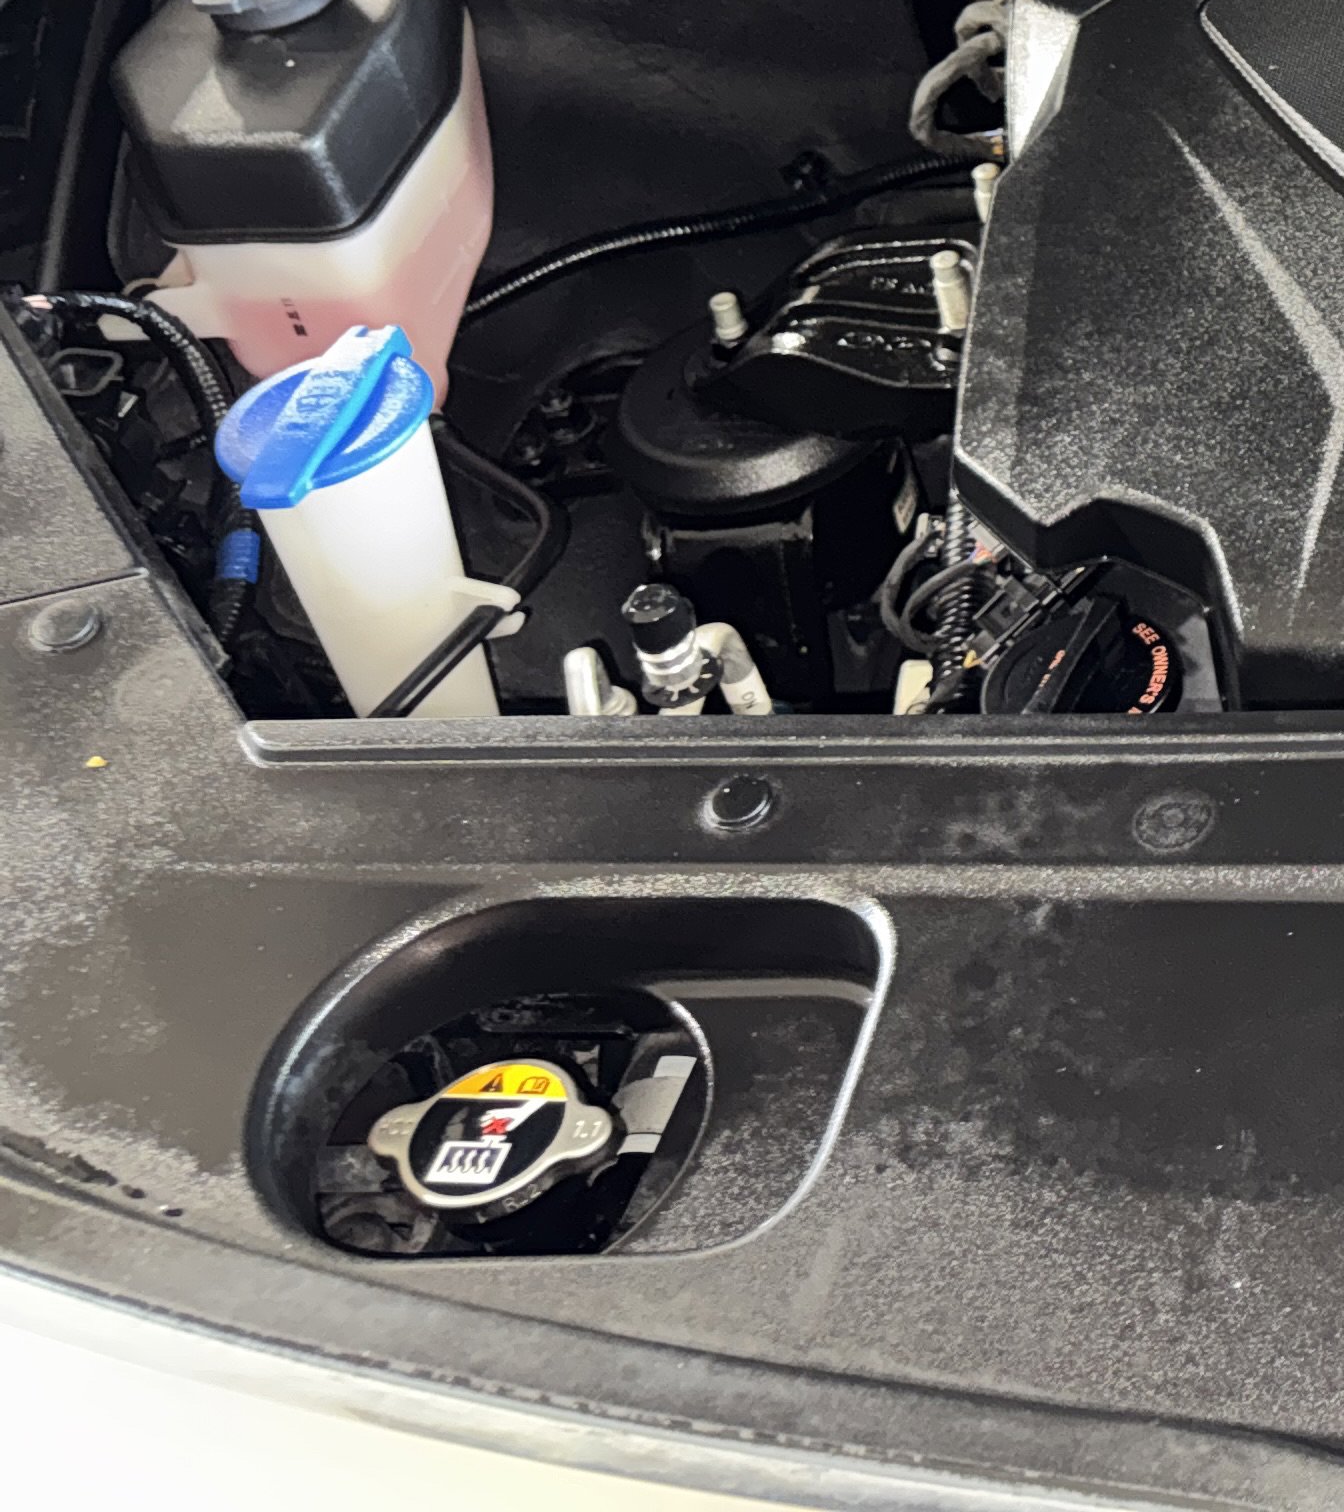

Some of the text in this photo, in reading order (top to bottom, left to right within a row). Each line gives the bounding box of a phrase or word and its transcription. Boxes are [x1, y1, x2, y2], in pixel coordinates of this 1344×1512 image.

[1132, 622, 1169, 704] SEE OWNER'S
[573, 1120, 602, 1138] 1.1
